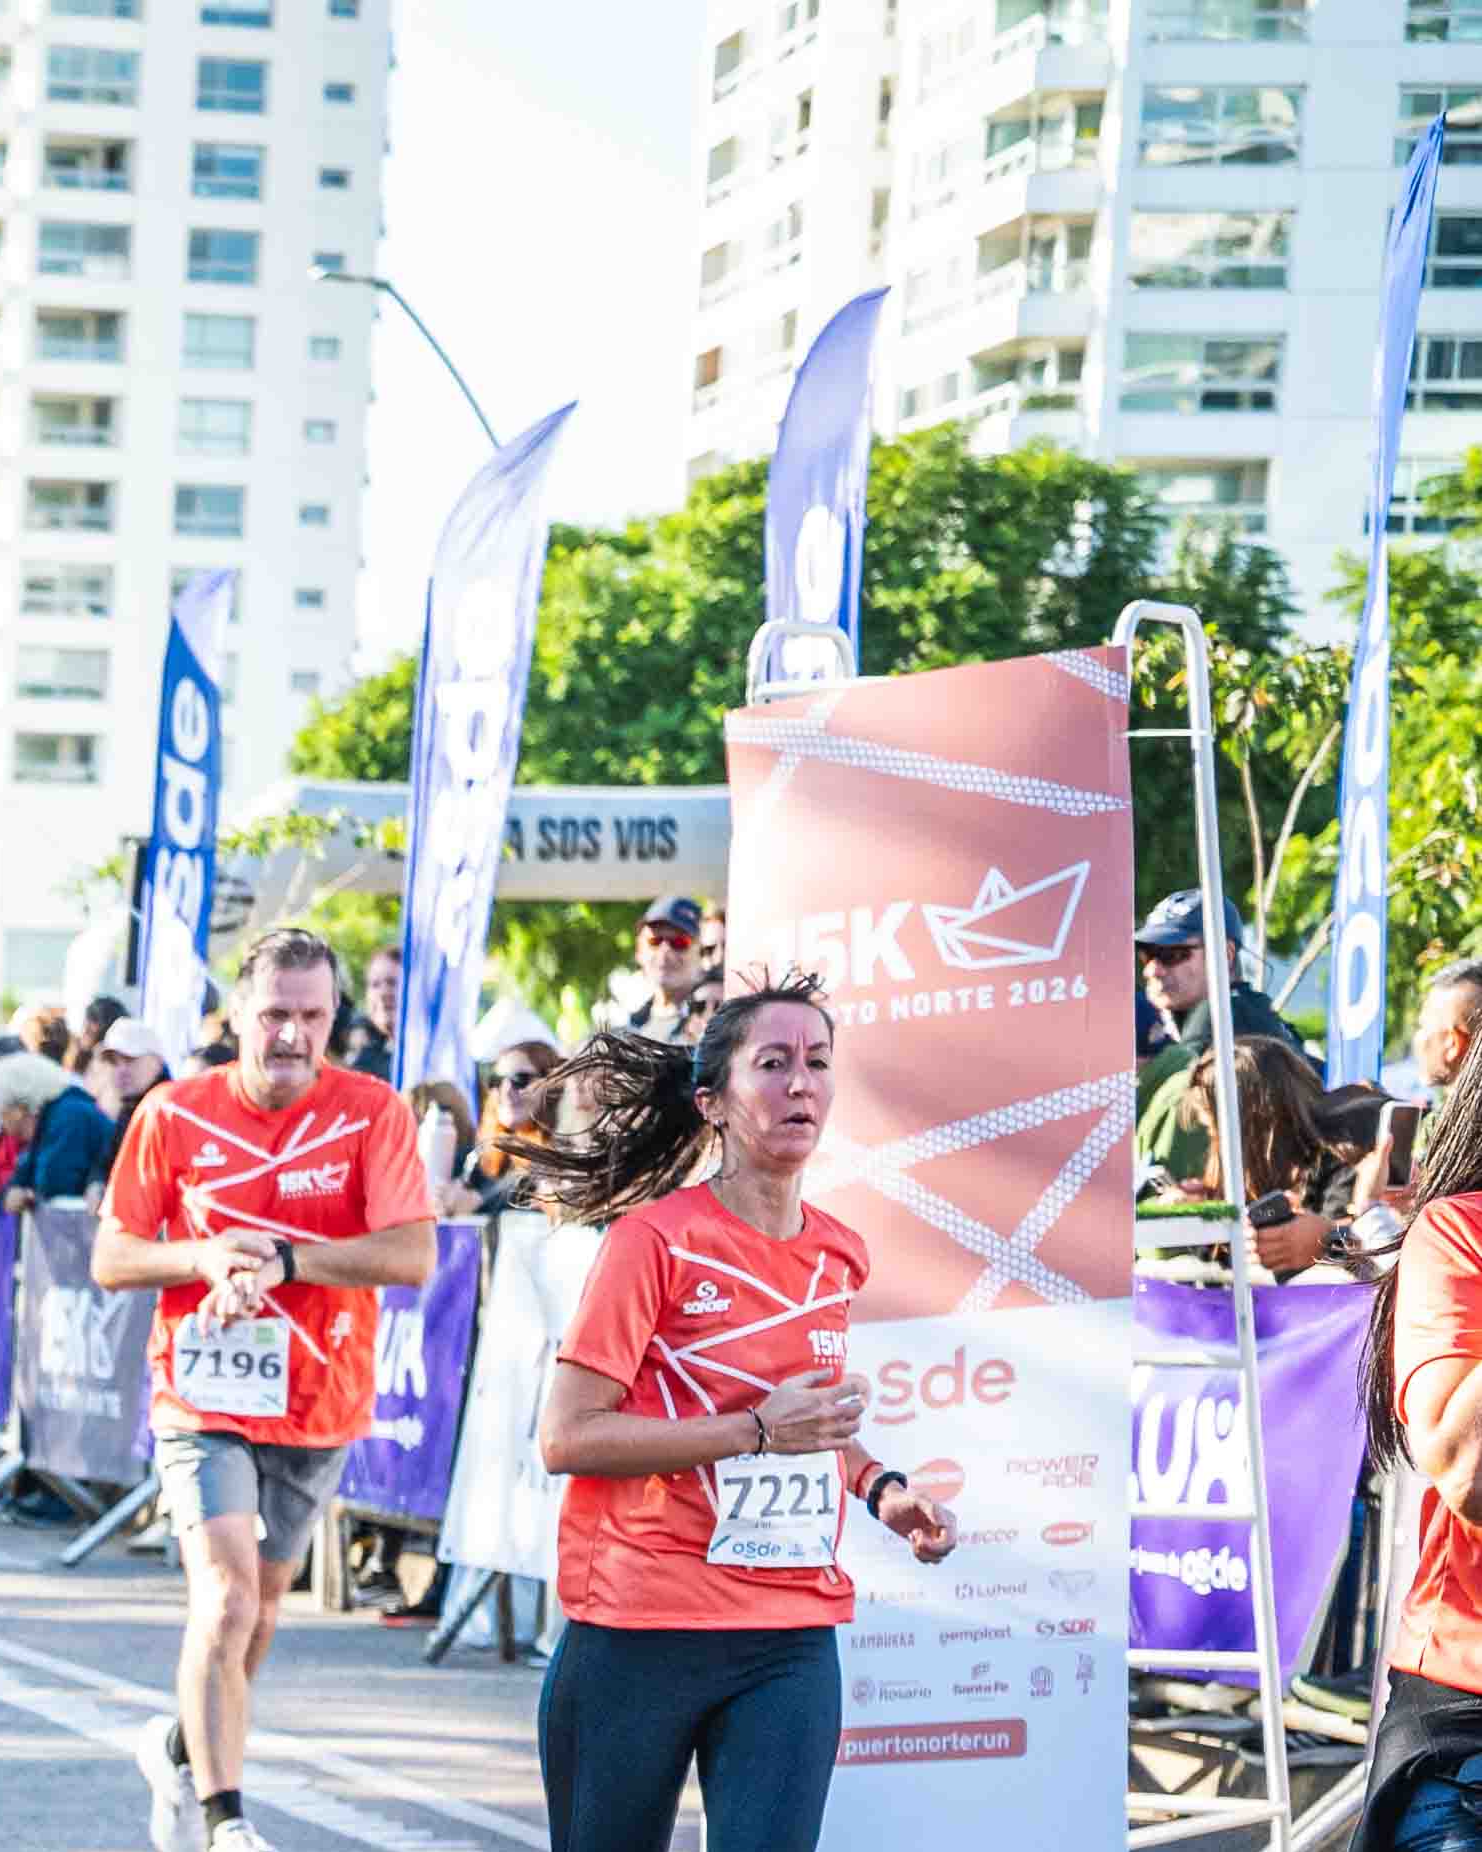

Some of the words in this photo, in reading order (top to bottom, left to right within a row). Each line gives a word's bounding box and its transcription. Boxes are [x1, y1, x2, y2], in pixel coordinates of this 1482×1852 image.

[890, 985, 996, 1024] NORTE
[1009, 974, 1090, 1007] 2026
[180, 1348, 283, 1380] 7196
[872, 1343, 1018, 1425] sde
[723, 1472, 835, 1520] 7221
